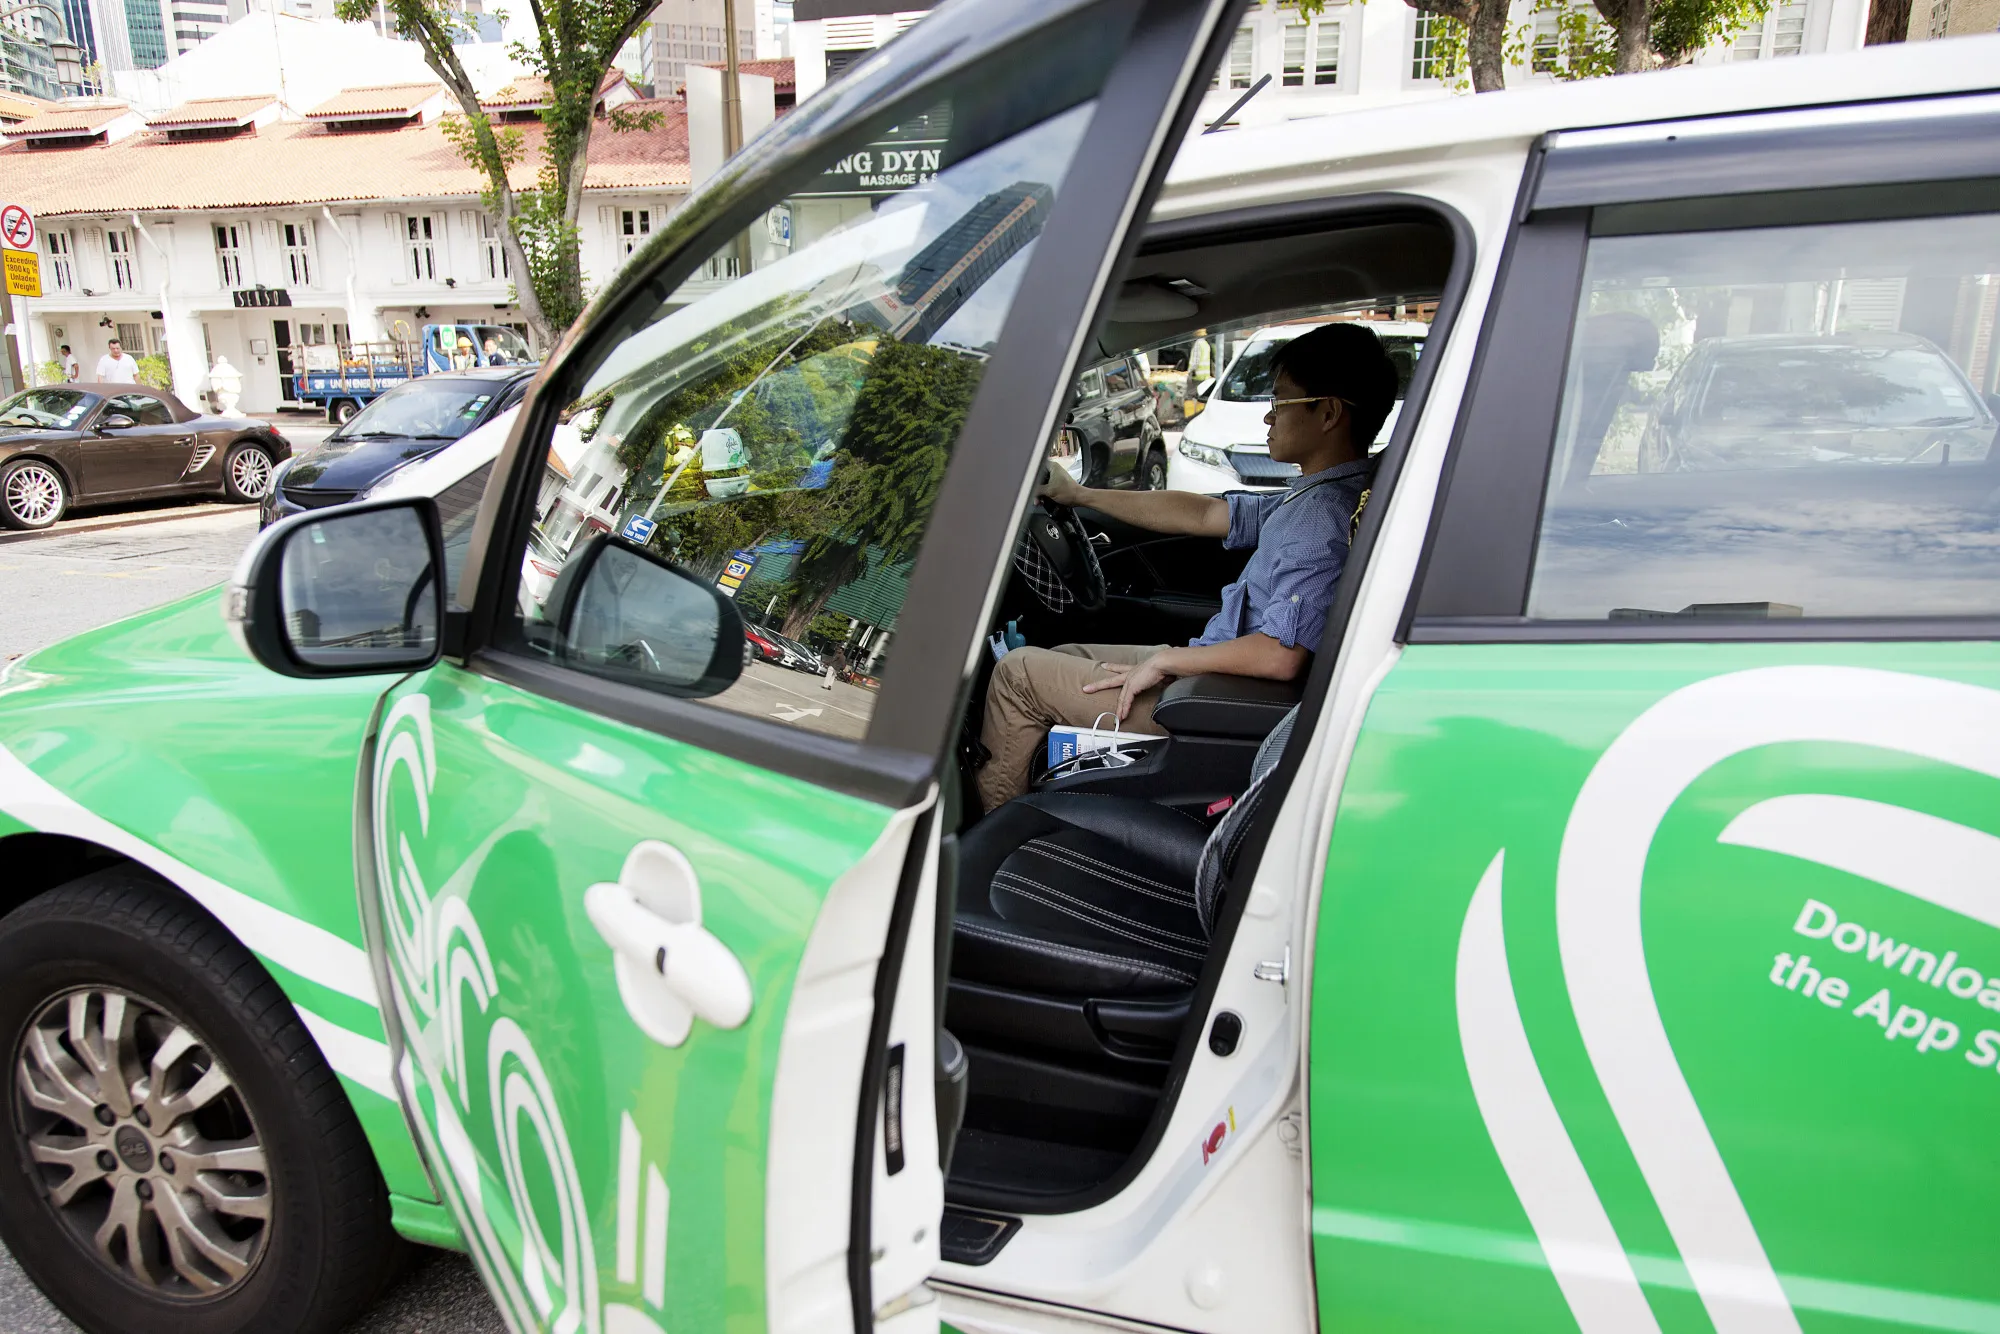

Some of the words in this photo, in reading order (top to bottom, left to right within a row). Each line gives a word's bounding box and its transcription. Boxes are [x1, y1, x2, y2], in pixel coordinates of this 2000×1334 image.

[821, 152, 873, 175] NG
[860, 174, 916, 186] MASSAGE
[919, 173, 928, 183] &
[5, 255, 37, 267] Exceeding
[11, 273, 36, 282] Unladen
[13, 282, 36, 291] Weight
[1768, 952, 1850, 1009] the
[1852, 988, 1960, 1053] App
[1964, 1029, 2000, 1076] S
